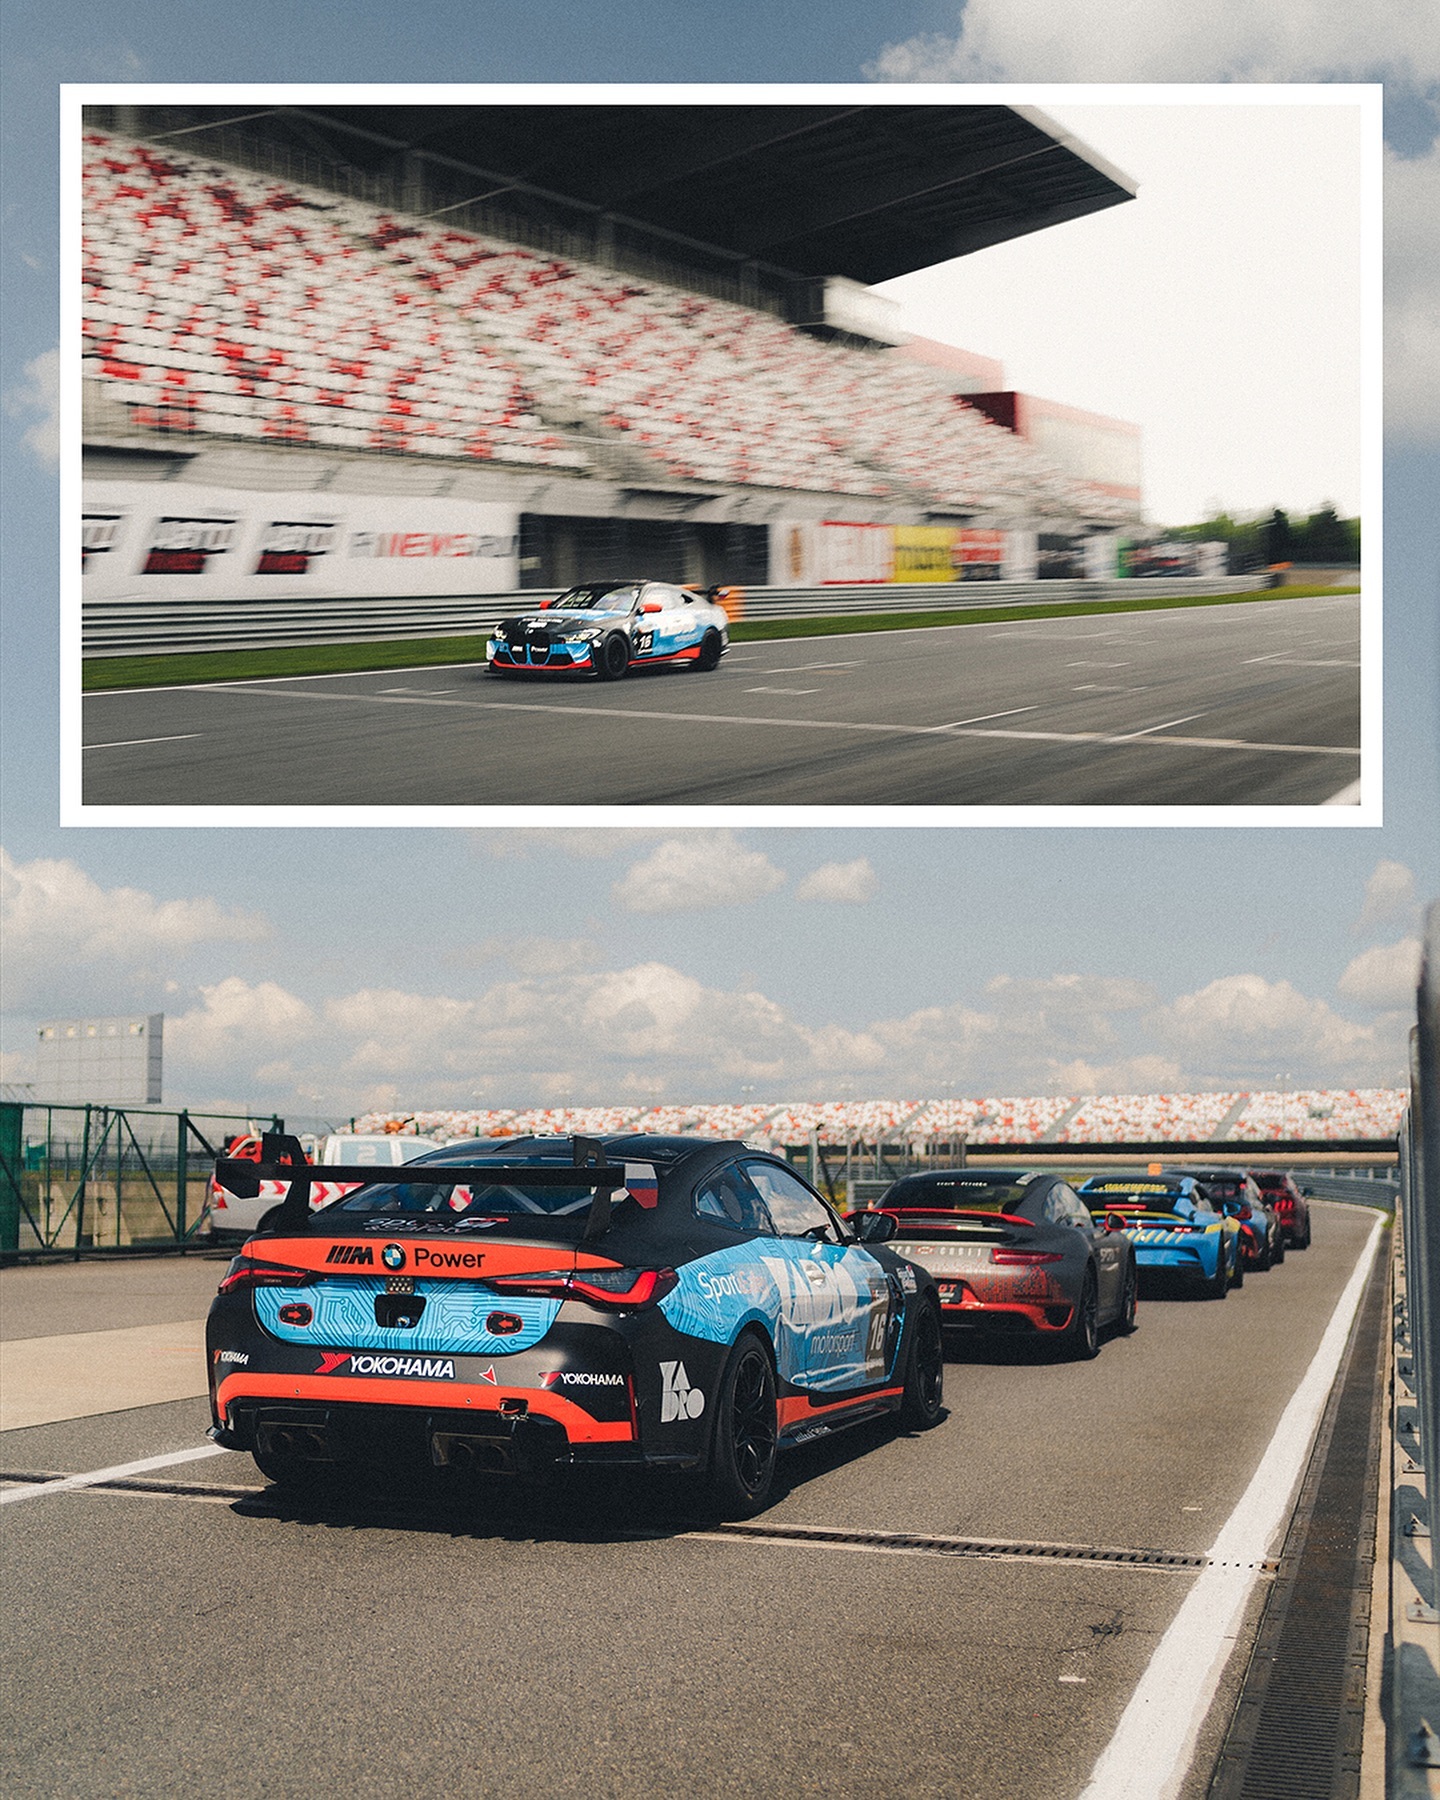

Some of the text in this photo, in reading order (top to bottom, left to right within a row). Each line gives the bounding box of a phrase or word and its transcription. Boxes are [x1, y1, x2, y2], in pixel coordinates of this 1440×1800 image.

[414, 1247, 486, 1268] Power
[870, 1313, 887, 1350] 16
[350, 1355, 455, 1378] YOKOHAMA
[560, 1372, 625, 1386] YOKOHAMA
